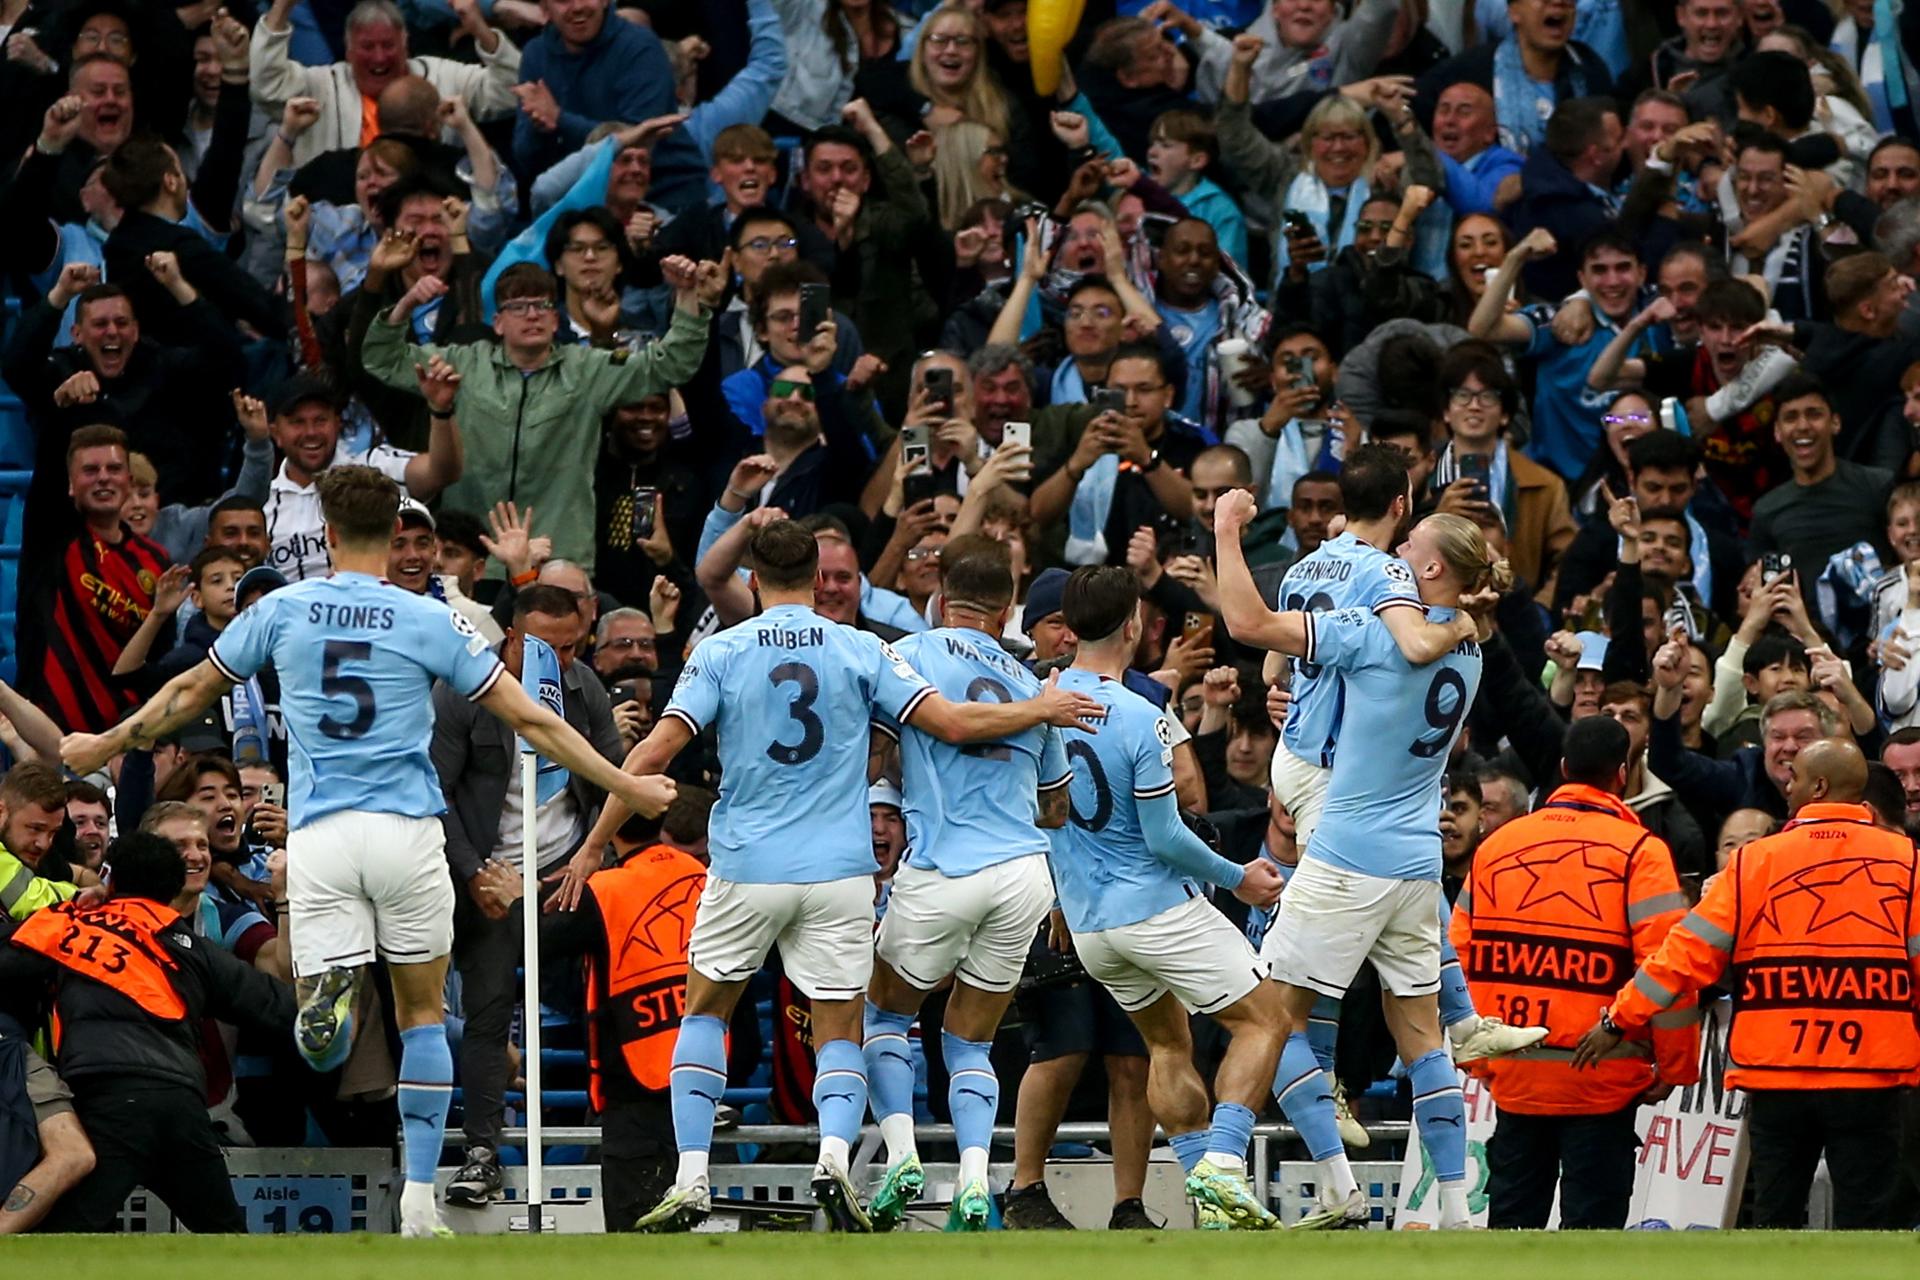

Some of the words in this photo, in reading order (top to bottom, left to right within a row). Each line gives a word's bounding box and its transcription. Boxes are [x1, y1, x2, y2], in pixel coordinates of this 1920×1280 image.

[309, 602, 396, 630] STONES
[758, 623, 823, 650] RÚBEN
[317, 639, 376, 741] 5
[766, 662, 824, 766] 3
[1408, 667, 1467, 758] 9
[59, 924, 131, 974] 213
[1742, 966, 1911, 1001] STEWARD
[1790, 1019, 1863, 1056] 779
[253, 1186, 299, 1201] Aisle
